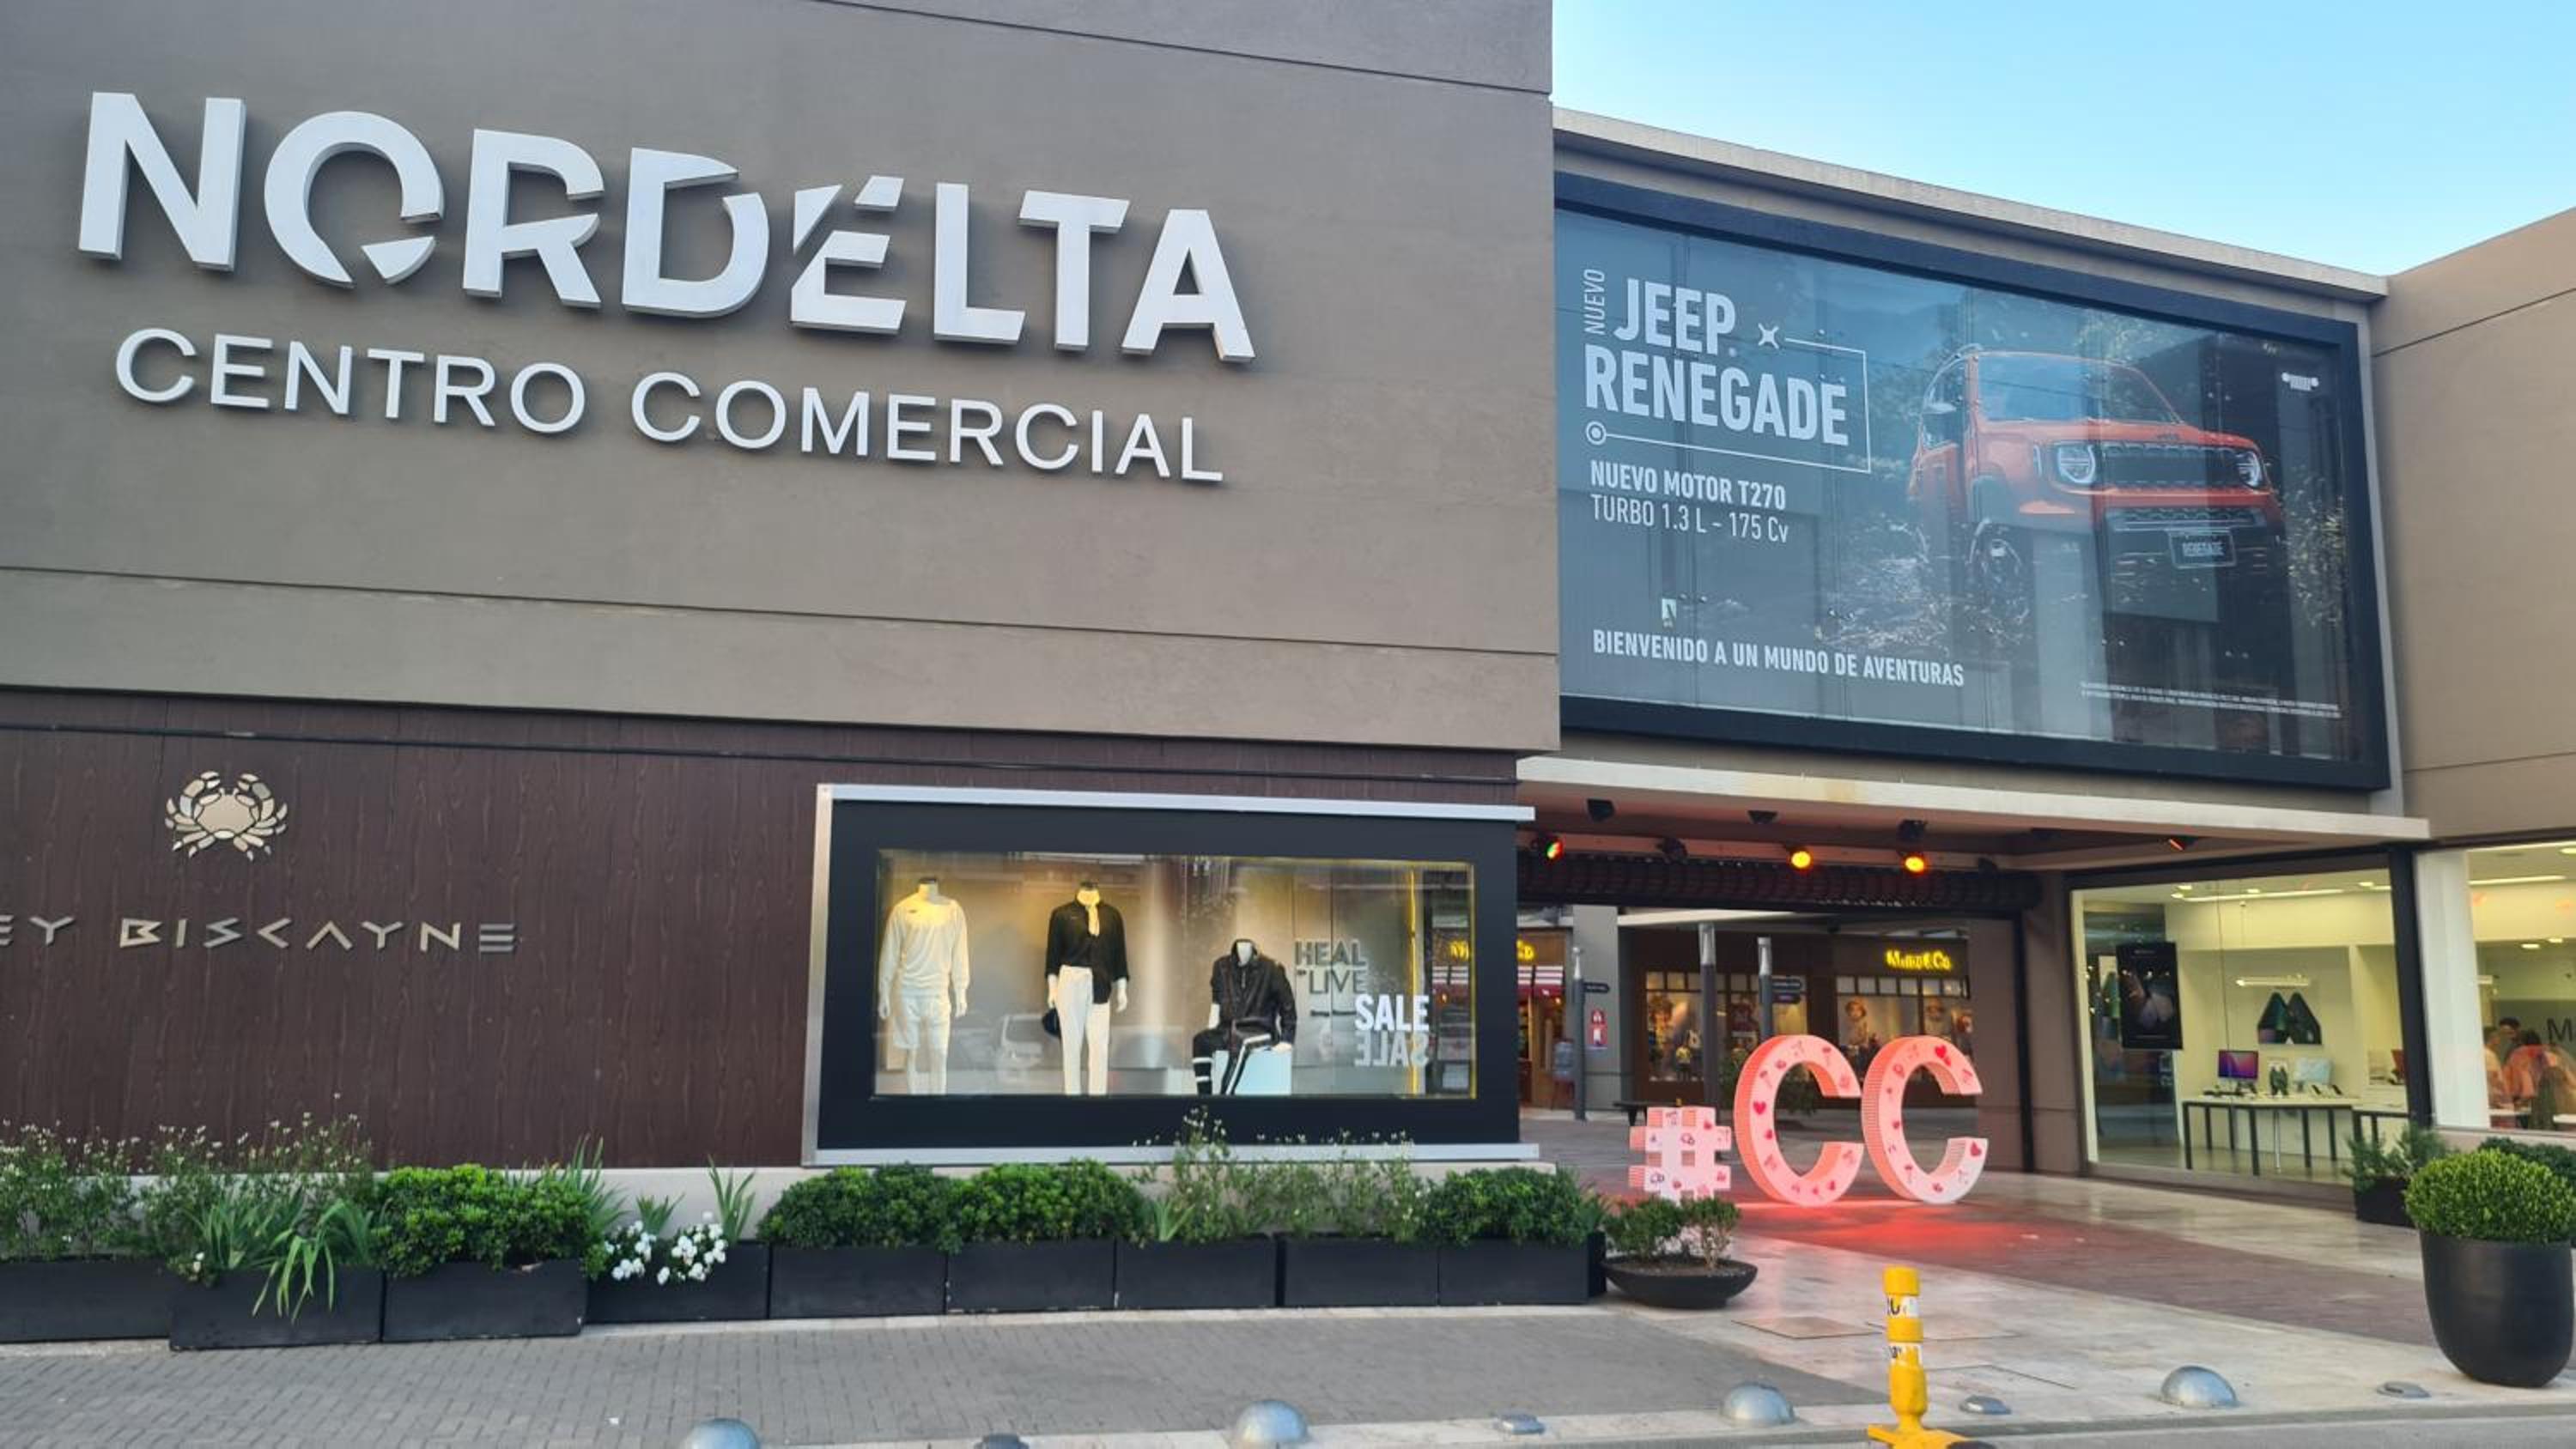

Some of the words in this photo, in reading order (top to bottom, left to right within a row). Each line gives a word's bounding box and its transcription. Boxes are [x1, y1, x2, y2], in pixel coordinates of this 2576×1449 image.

[79, 91, 1255, 362] NORDELTA
[1583, 269, 1606, 336] NUEVO
[1613, 277, 1736, 355] JEEP
[116, 327, 586, 433] CENTRO
[631, 372, 1224, 482] COMERCIAL
[1584, 343, 1849, 446] RENEGADE
[1590, 459, 1658, 494] NUEVO
[1663, 469, 1734, 504] MOTOR
[1737, 480, 1786, 511] T270
[1590, 494, 1655, 526] TURBO
[1662, 503, 1689, 531] 1.3
[1696, 507, 1707, 534] L
[1728, 512, 1762, 540] 175
[1767, 516, 1789, 543] Cv
[1593, 629, 1708, 664] BIENVENIDO
[1714, 640, 1728, 665] A
[1732, 642, 1759, 667] UN
[1764, 645, 1829, 674] MUNDO
[1834, 652, 1858, 677] DE
[1862, 655, 1965, 687] AVENTURAS
[118, 918, 515, 953] BISCAYNE
[1295, 940, 1367, 967] HEAL
[1309, 969, 1368, 994] LIVE
[1354, 993, 1430, 1032] SALE
